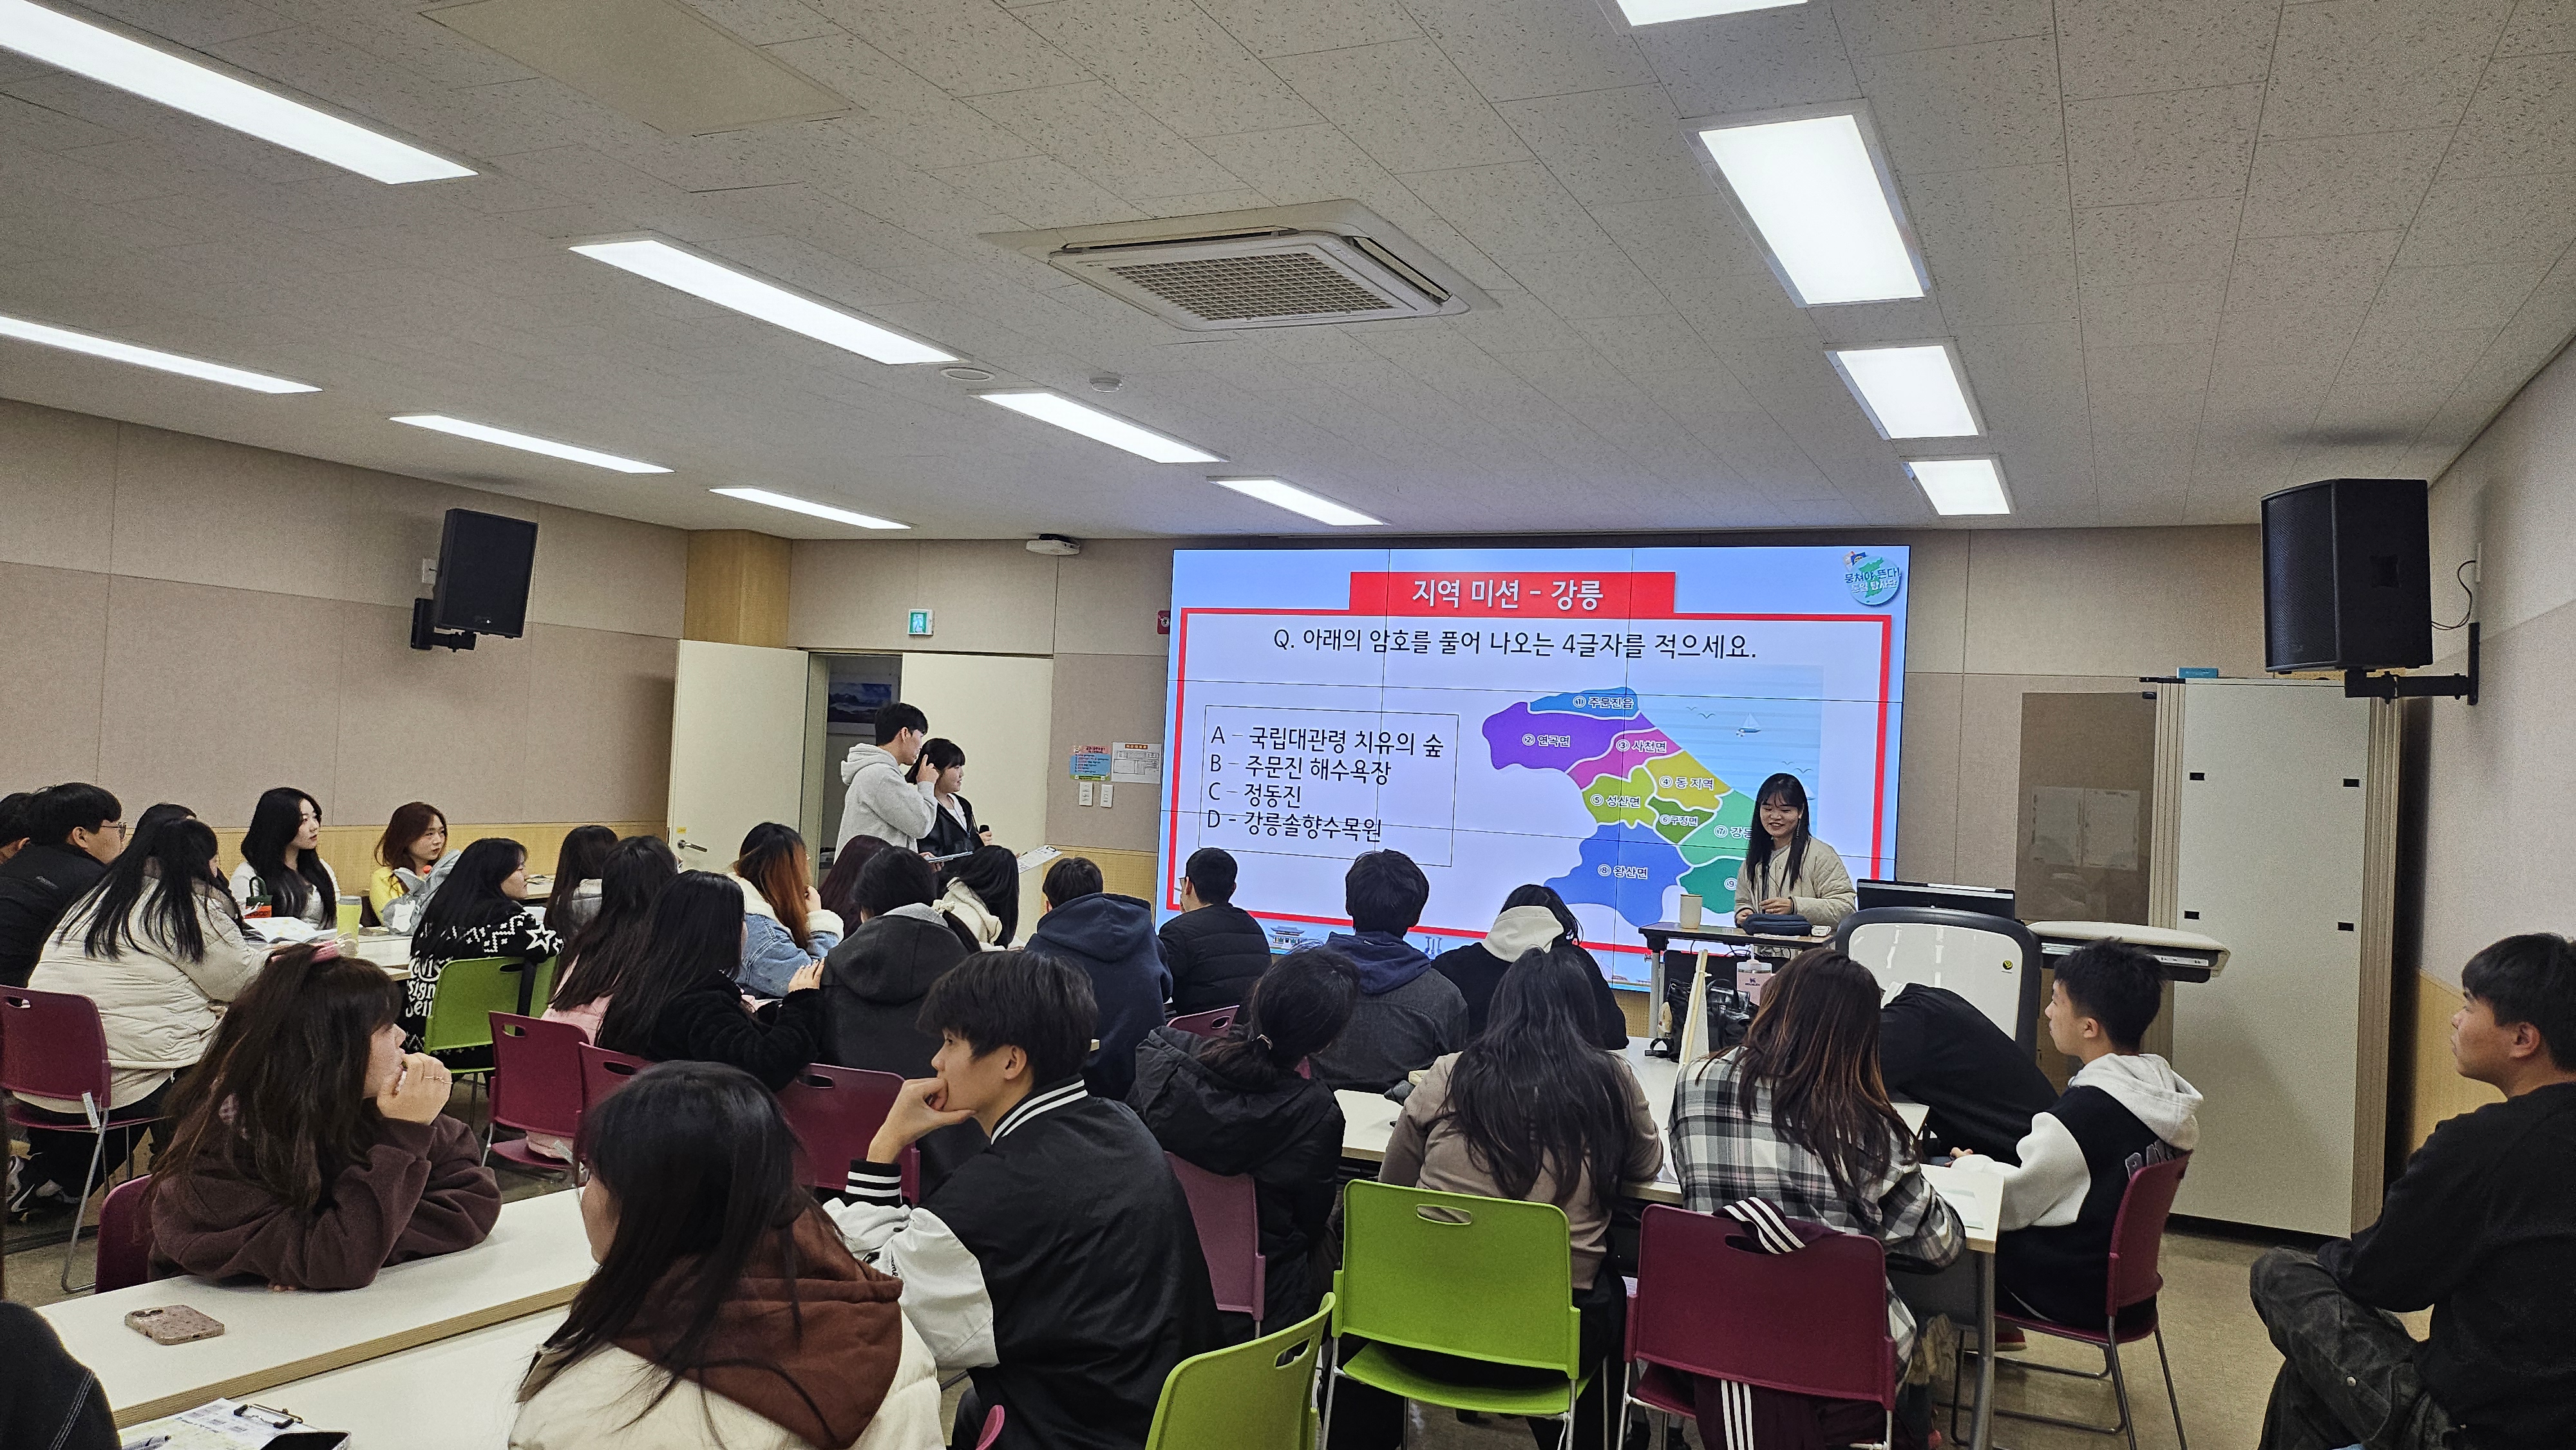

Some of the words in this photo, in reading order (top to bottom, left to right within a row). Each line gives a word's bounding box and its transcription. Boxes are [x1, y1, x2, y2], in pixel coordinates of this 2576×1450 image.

[1844, 570, 1874, 583] 뭉쳐야
[1877, 567, 1900, 579] 뜬다!
[1412, 579, 1460, 608] 지역
[1471, 579, 1519, 608] 미션
[1551, 579, 1604, 611] 강릉
[1274, 628, 1295, 650] Q.
[1303, 628, 1361, 652] 아래의
[1369, 629, 1432, 654] 암호를
[1438, 630, 1480, 655] 풀어
[1490, 632, 1555, 657] 나오는
[1562, 633, 1646, 659] 4글자를
[1654, 634, 1757, 660] 적으세요.
[1210, 726, 1226, 744] A
[1248, 727, 1347, 754] 국립대관령
[1354, 730, 1416, 756] 치유의
[1423, 733, 1444, 758] 숲
[1537, 735, 1571, 748] 연곡면
[1632, 740, 1667, 753] 사천면
[1210, 754, 1222, 773] B
[1245, 755, 1302, 780] 주문진
[1310, 758, 1392, 786] 해수욕장
[1675, 777, 1688, 789] 동
[1689, 777, 1714, 791] 지역
[1208, 782, 1220, 800] C
[1244, 783, 1301, 809] 정동진
[1605, 795, 1641, 808] 성산면
[1208, 809, 1220, 828] D
[1244, 811, 1382, 843] 강릉솔향수목원
[1613, 865, 1648, 880] 왕산면
